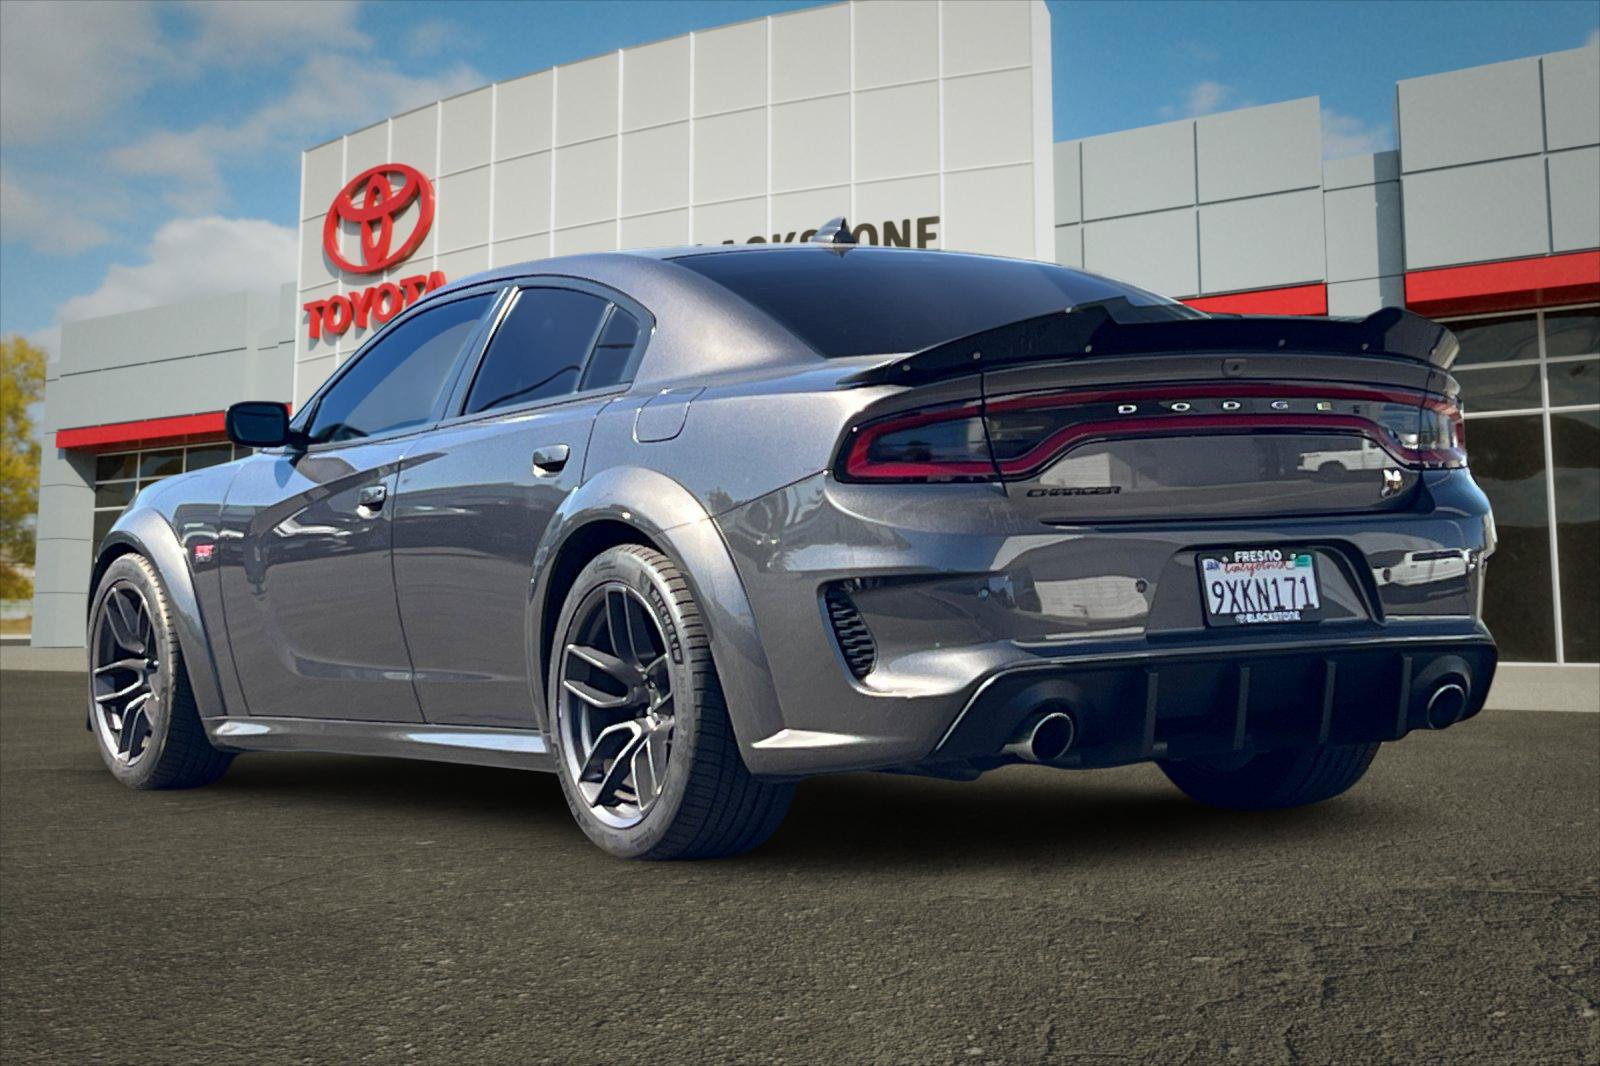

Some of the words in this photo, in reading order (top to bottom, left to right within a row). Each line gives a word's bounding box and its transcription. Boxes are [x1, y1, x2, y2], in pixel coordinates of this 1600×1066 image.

[1117, 401, 1333, 414] DODGE
[1234, 549, 1282, 562] FRESNO
[1211, 576, 1315, 615] 9XKN171
